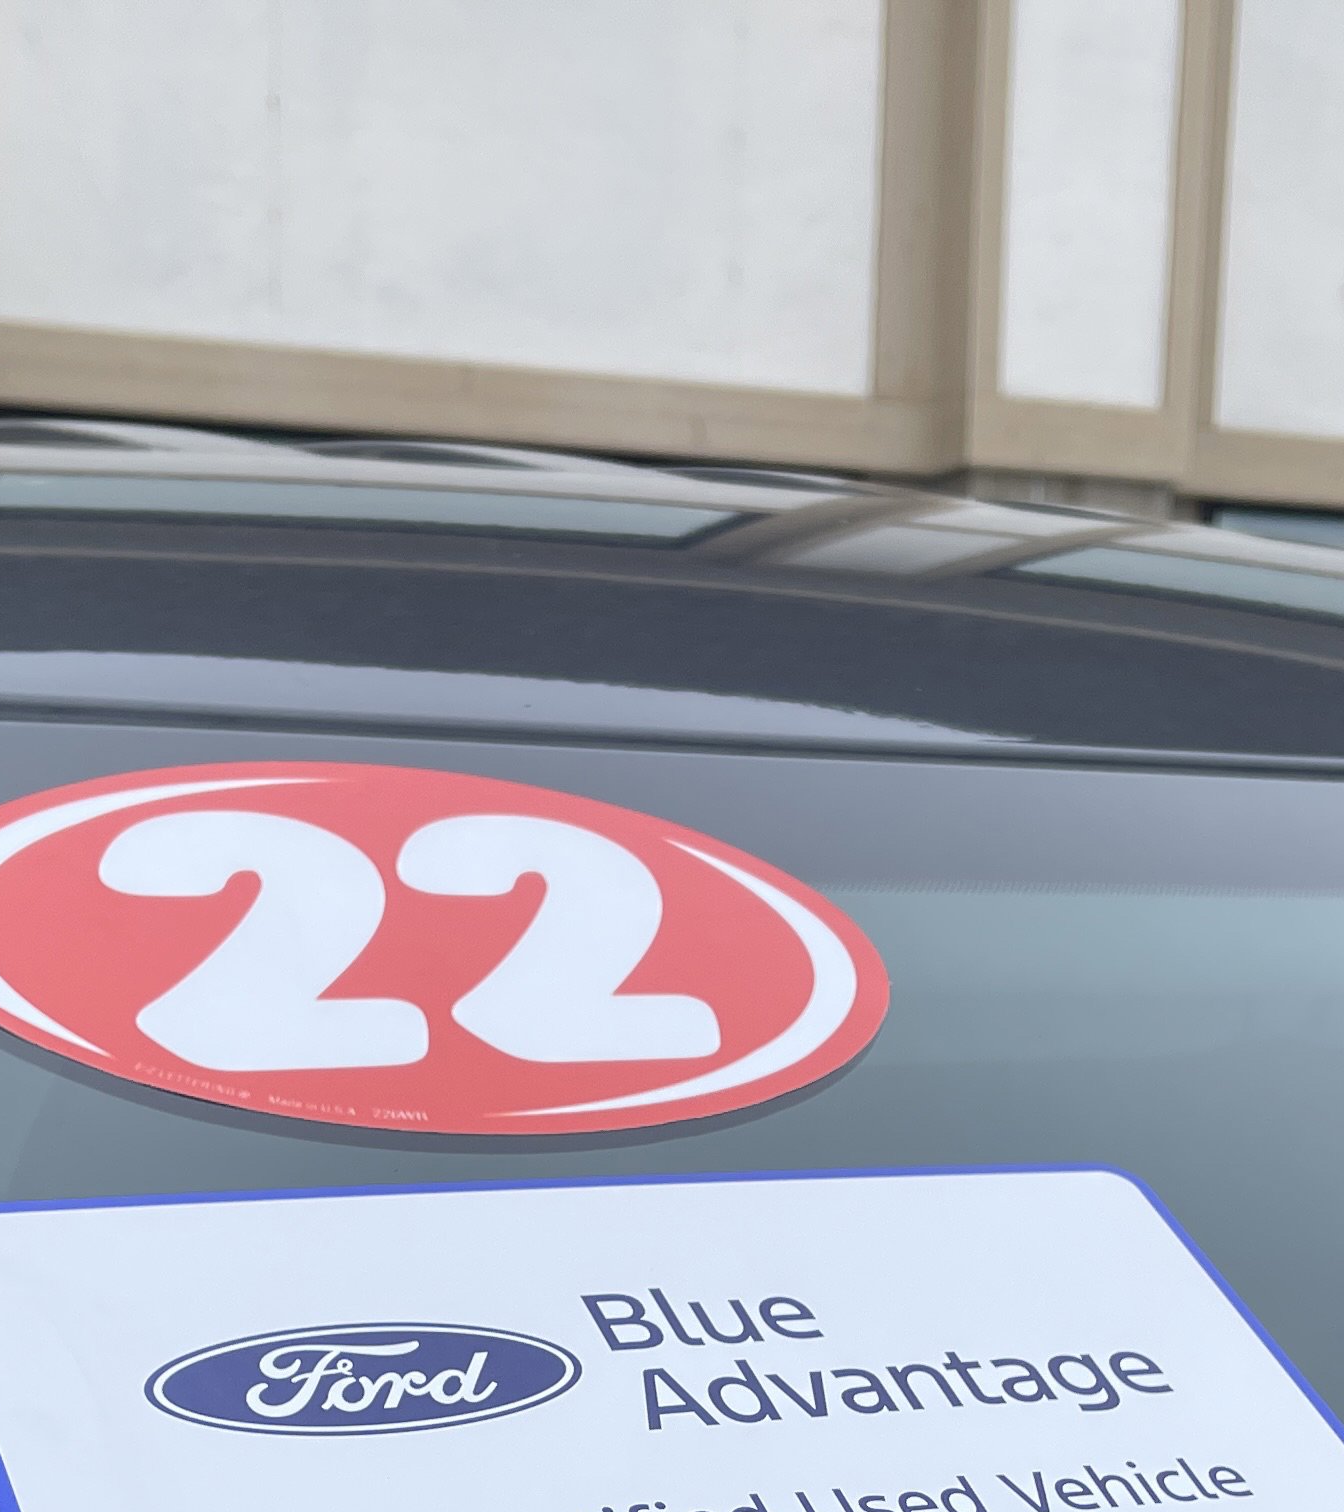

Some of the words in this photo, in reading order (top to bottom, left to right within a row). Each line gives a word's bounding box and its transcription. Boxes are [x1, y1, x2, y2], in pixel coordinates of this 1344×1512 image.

[99, 809, 722, 1072] 22
[581, 1287, 824, 1352] Blue
[245, 1340, 498, 1418] Ford
[642, 1350, 1174, 1432] Advantage
